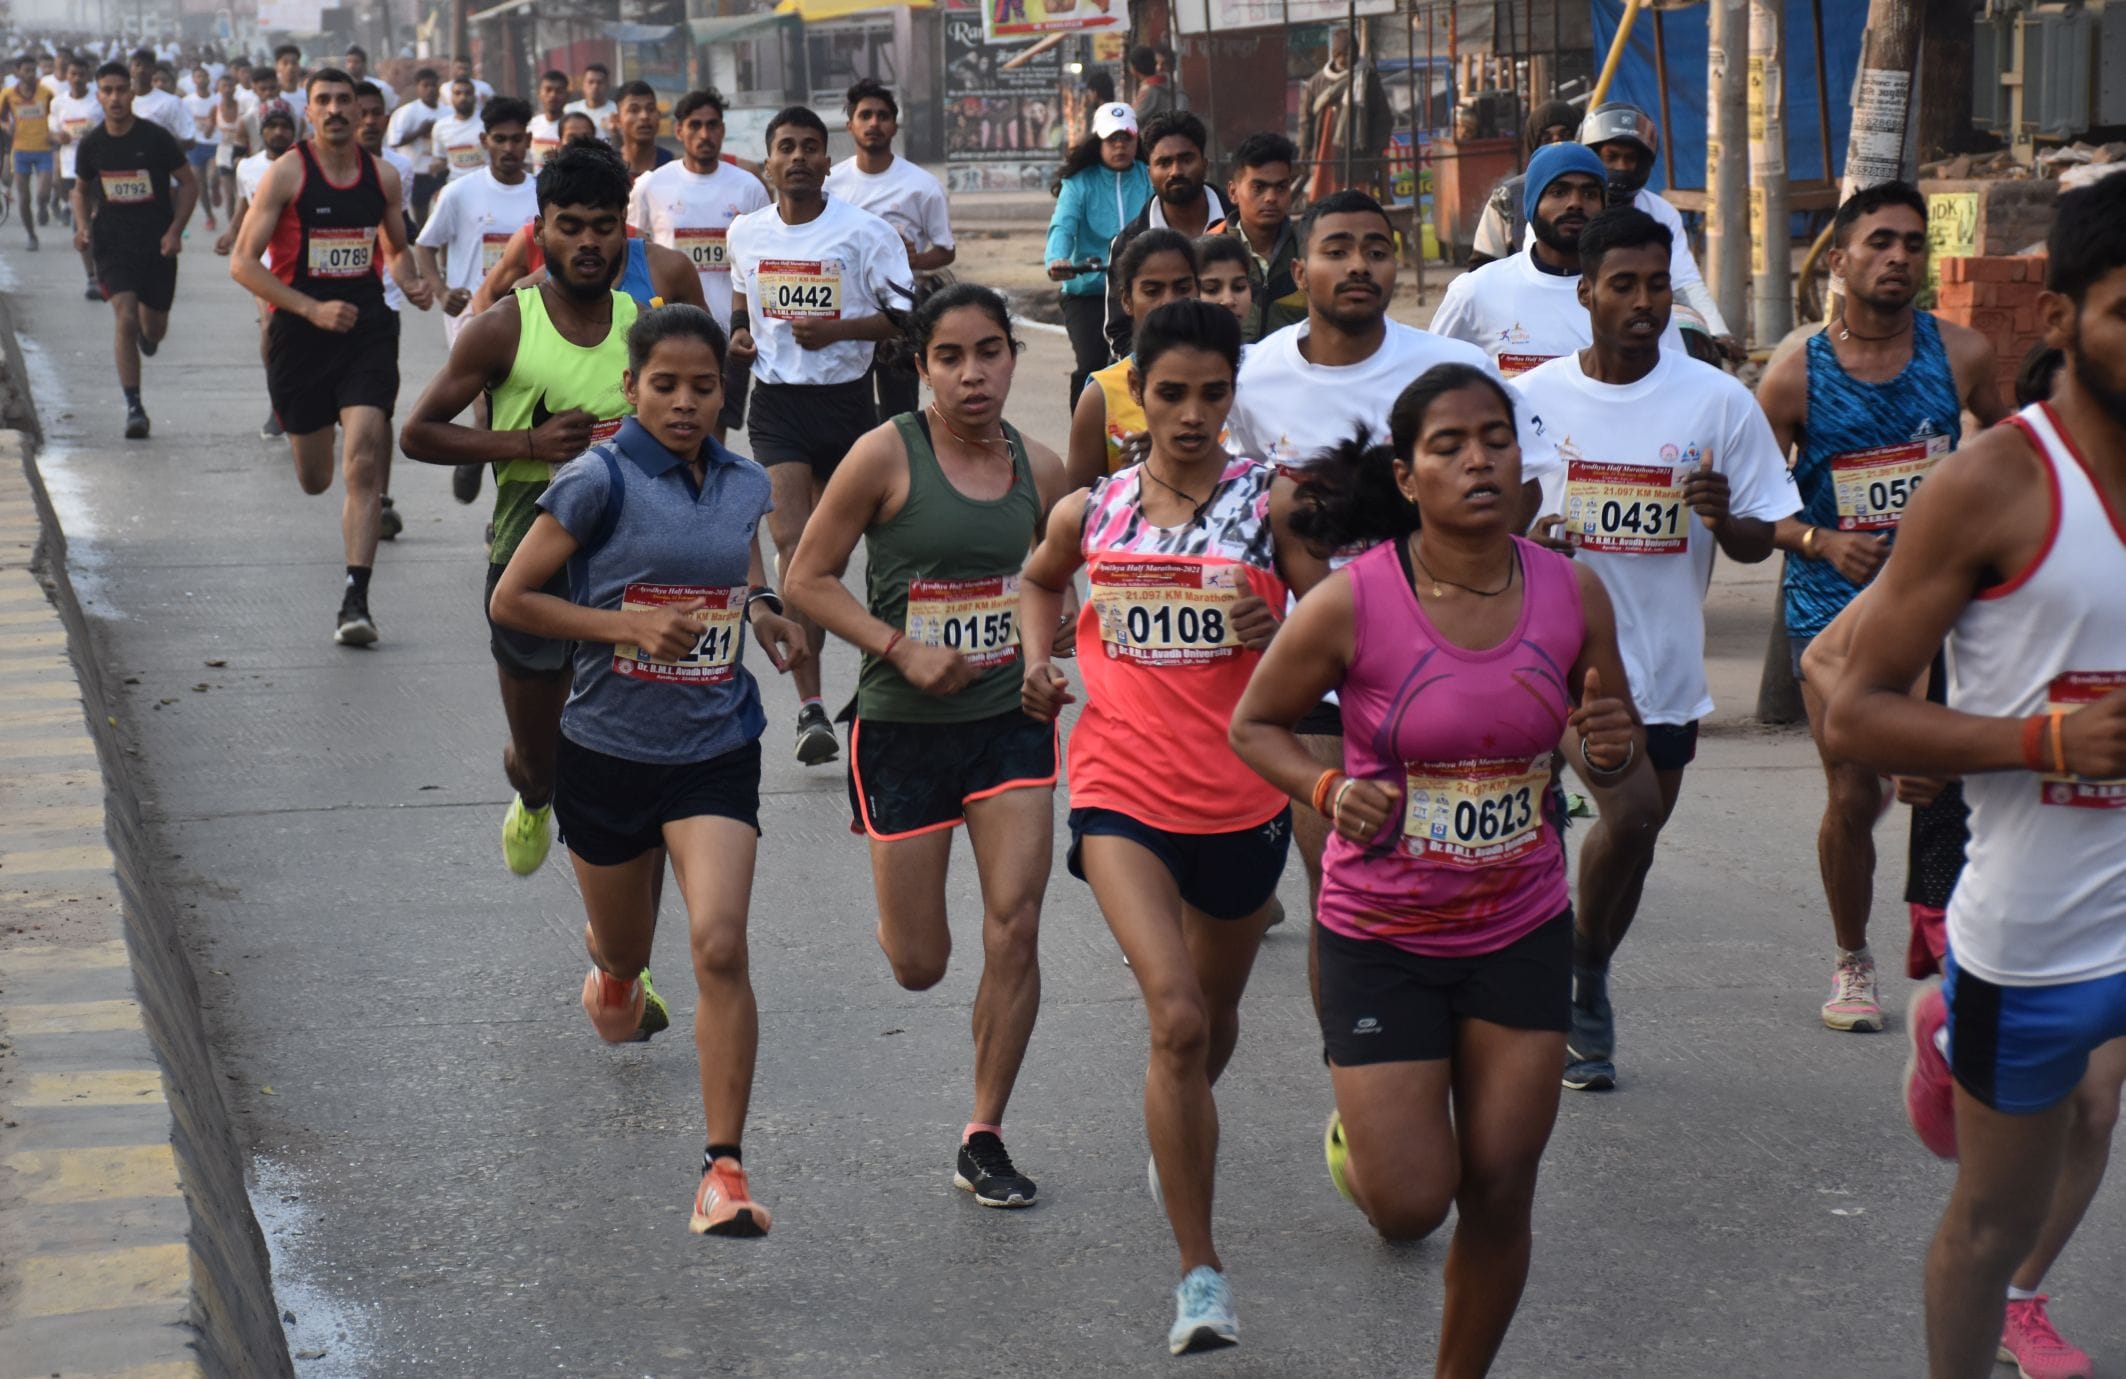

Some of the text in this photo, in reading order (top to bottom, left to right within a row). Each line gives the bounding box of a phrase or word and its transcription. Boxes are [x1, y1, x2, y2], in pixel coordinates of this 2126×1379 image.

[115, 183, 146, 195] 0792
[330, 247, 369, 267] 0789
[693, 246, 728, 262] 019
[779, 285, 832, 307] 0442
[1603, 486, 1634, 496] 21.097
[1636, 487, 1652, 497] KM
[1601, 501, 1679, 534] 0431
[1126, 564, 1144, 572] Half
[667, 587, 683, 595] Half
[1126, 590, 1161, 600] 21.097
[1165, 591, 1182, 600] KM
[1185, 592, 1235, 602] Marathon
[944, 611, 1012, 650] 0155
[1127, 606, 1225, 644] 0108
[1151, 649, 1181, 659] Avadh
[1183, 647, 1233, 659] University
[637, 662, 648, 672] Dr.
[675, 666, 701, 677] Avadh
[1454, 787, 1532, 841] 0623
